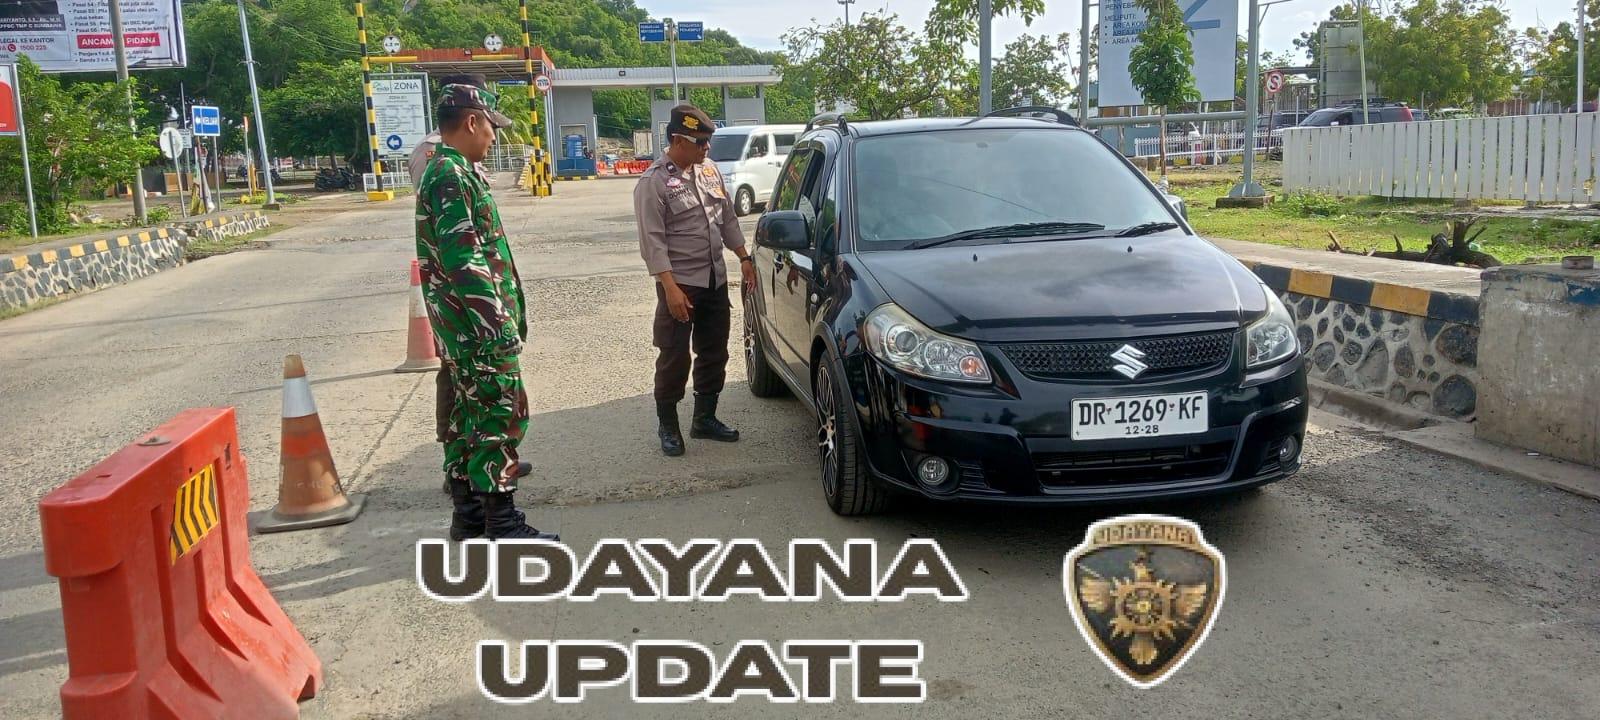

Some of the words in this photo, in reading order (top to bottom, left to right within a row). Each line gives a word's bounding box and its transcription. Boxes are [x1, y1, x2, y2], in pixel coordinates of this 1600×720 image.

[126, 37, 156, 45] PIDANA
[1112, 37, 1130, 45] AREA
[393, 82, 420, 90] ZONA
[1079, 402, 1106, 426] DR
[1114, 399, 1168, 424] 1269
[1178, 395, 1203, 420] KF
